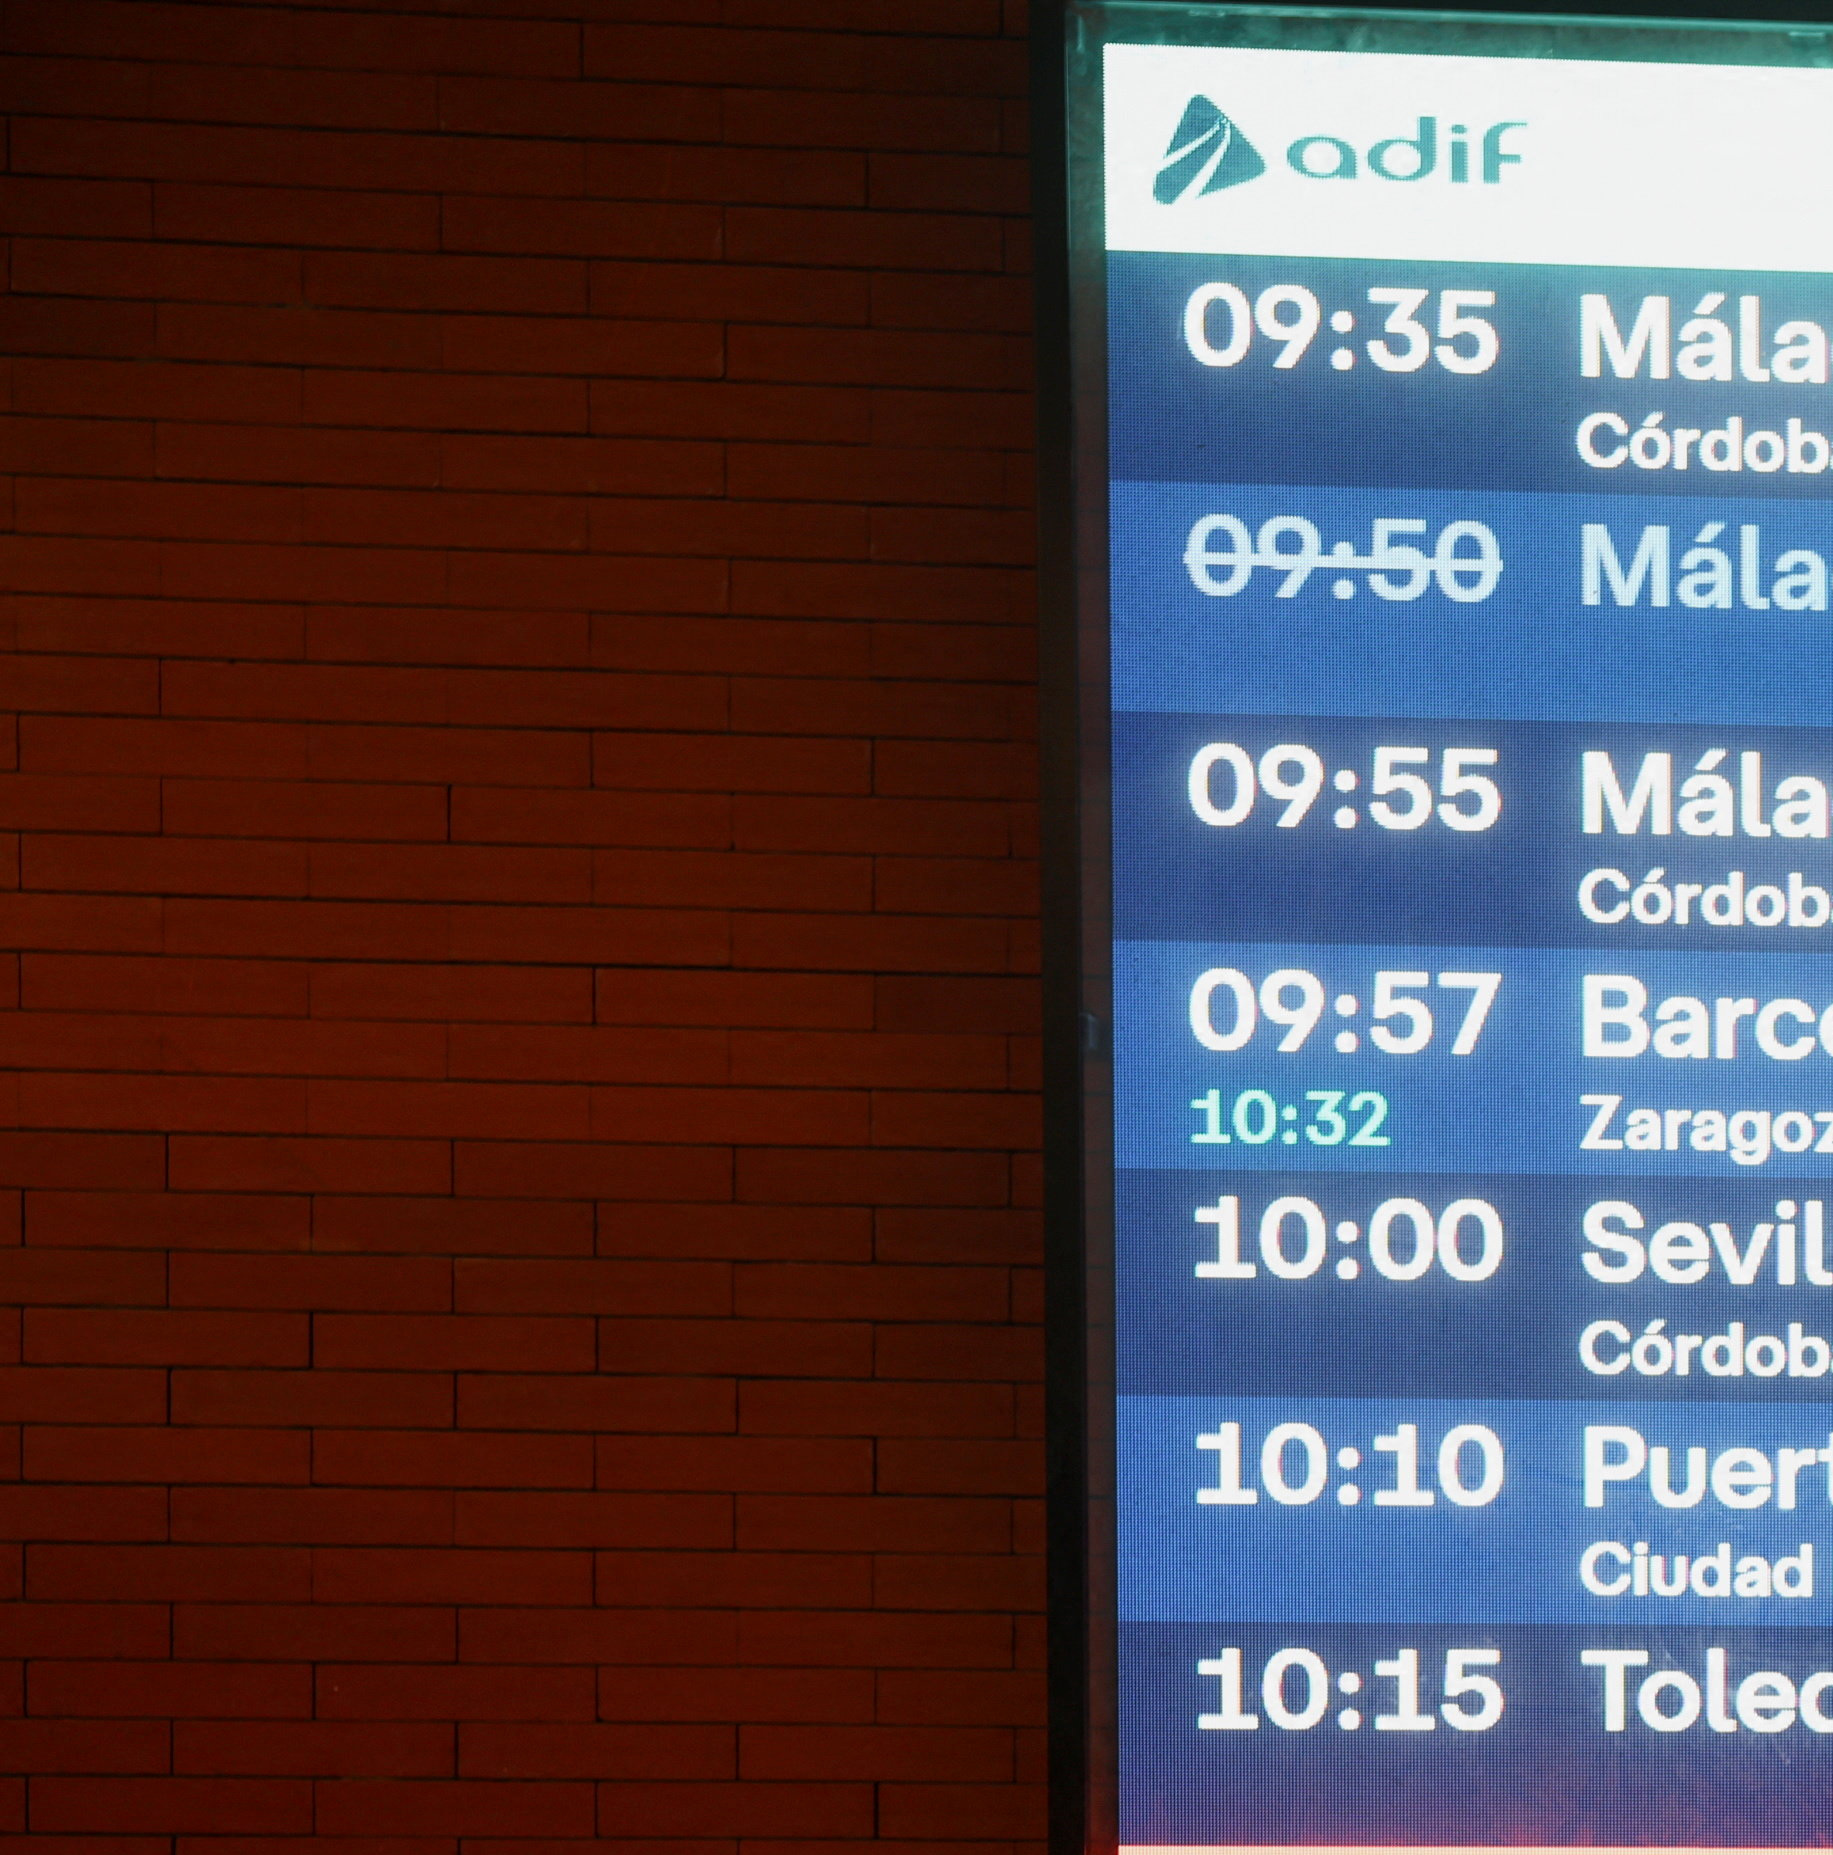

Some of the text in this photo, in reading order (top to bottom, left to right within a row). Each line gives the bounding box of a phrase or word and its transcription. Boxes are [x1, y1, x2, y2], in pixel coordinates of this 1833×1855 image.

[1286, 115, 1527, 185] adif
[1184, 282, 1499, 375] 09:35
[1183, 513, 1504, 602] 09:50
[1188, 742, 1501, 832] 09:55
[1189, 968, 1502, 1055] 09:57
[1190, 1088, 1391, 1147] 10:32
[1195, 1195, 1504, 1282] 10:00
[1197, 1422, 1504, 1507] 10:10
[1579, 1541, 1813, 1598] Ciudad
[1198, 1647, 1504, 1732] 10:15
